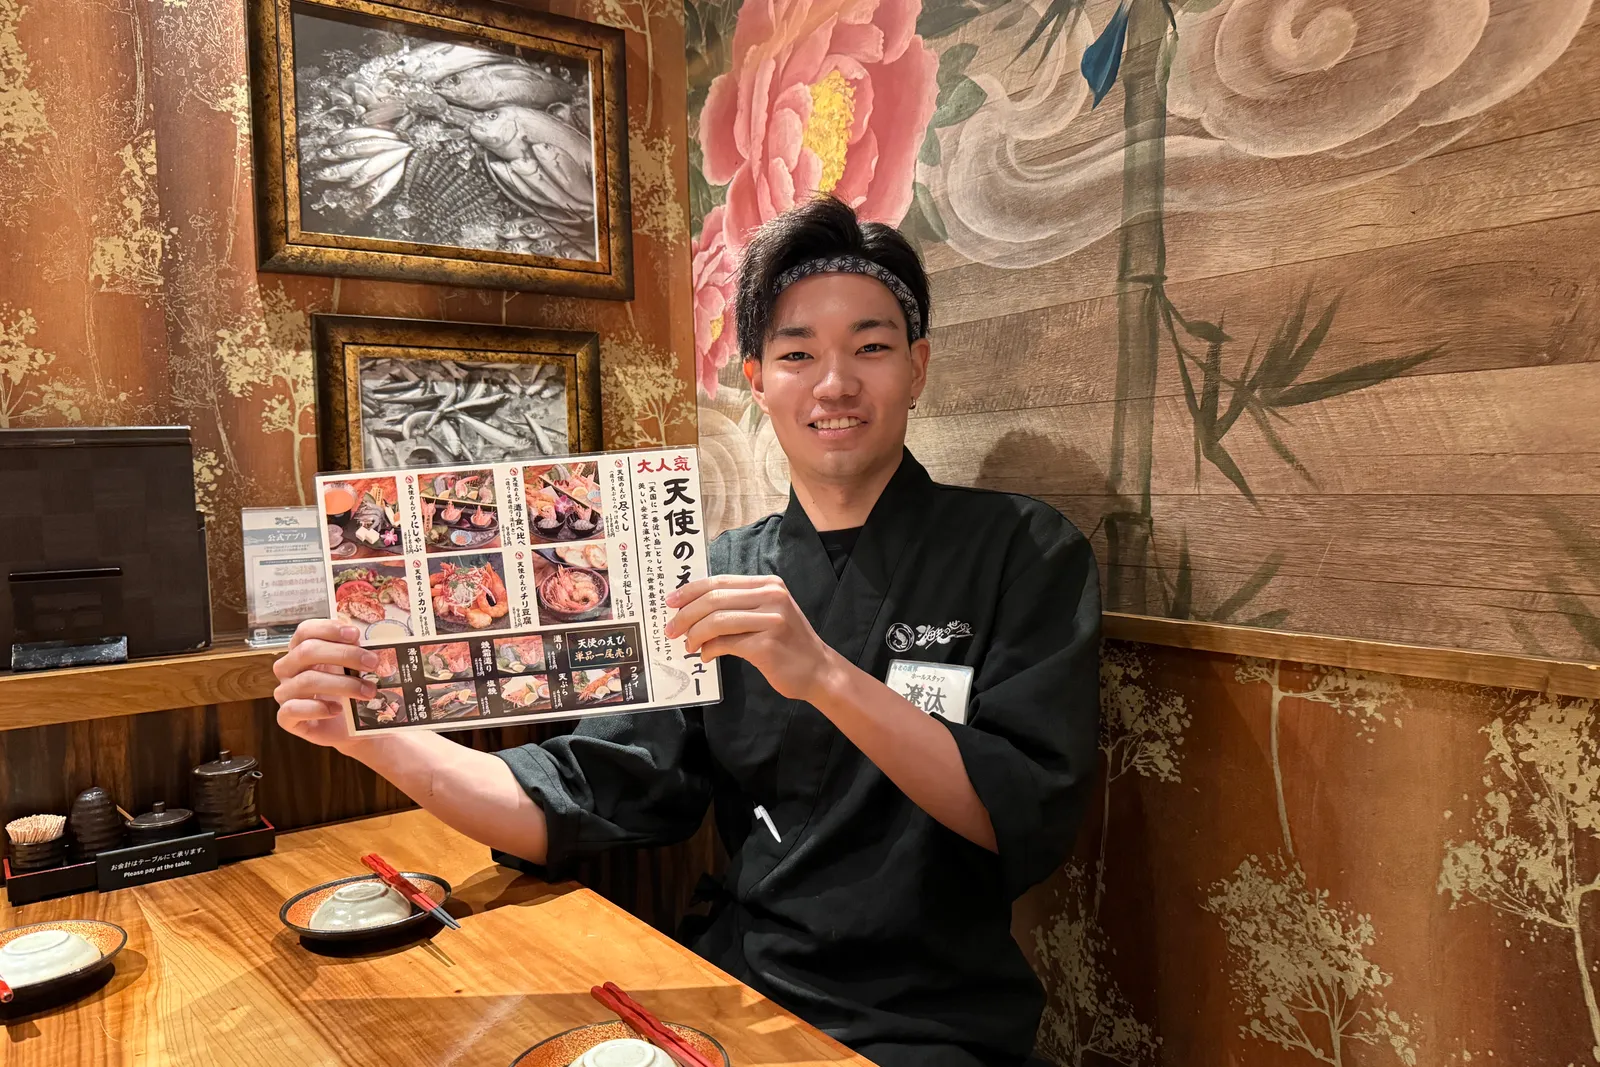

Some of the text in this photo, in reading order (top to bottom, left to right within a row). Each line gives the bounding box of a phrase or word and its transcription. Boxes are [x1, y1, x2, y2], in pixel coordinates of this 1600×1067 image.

[637, 455, 691, 474] 大人気
[268, 532, 307, 542] 公式アプリ
[415, 569, 427, 614] 天使のえびカツ
[517, 561, 532, 625] 天使のえびチリ豆腐
[663, 478, 708, 696] 天使のえュー
[553, 634, 562, 650] 造り
[577, 635, 626, 650] 天使のえび
[407, 648, 419, 671] 湯引き
[574, 647, 633, 662] 単品一尾売り
[558, 673, 568, 696] 天ぷら
[630, 666, 639, 688] フライ
[911, 673, 945, 682] ホールスタッフ
[487, 680, 498, 695] 塩焼
[415, 687, 428, 719] のっけ寿司
[110, 847, 206, 871] お会計はテーブルにて承ります。
[123, 869, 144, 878] Please
[144, 867, 156, 875] pay
[175, 860, 192, 868] table.
